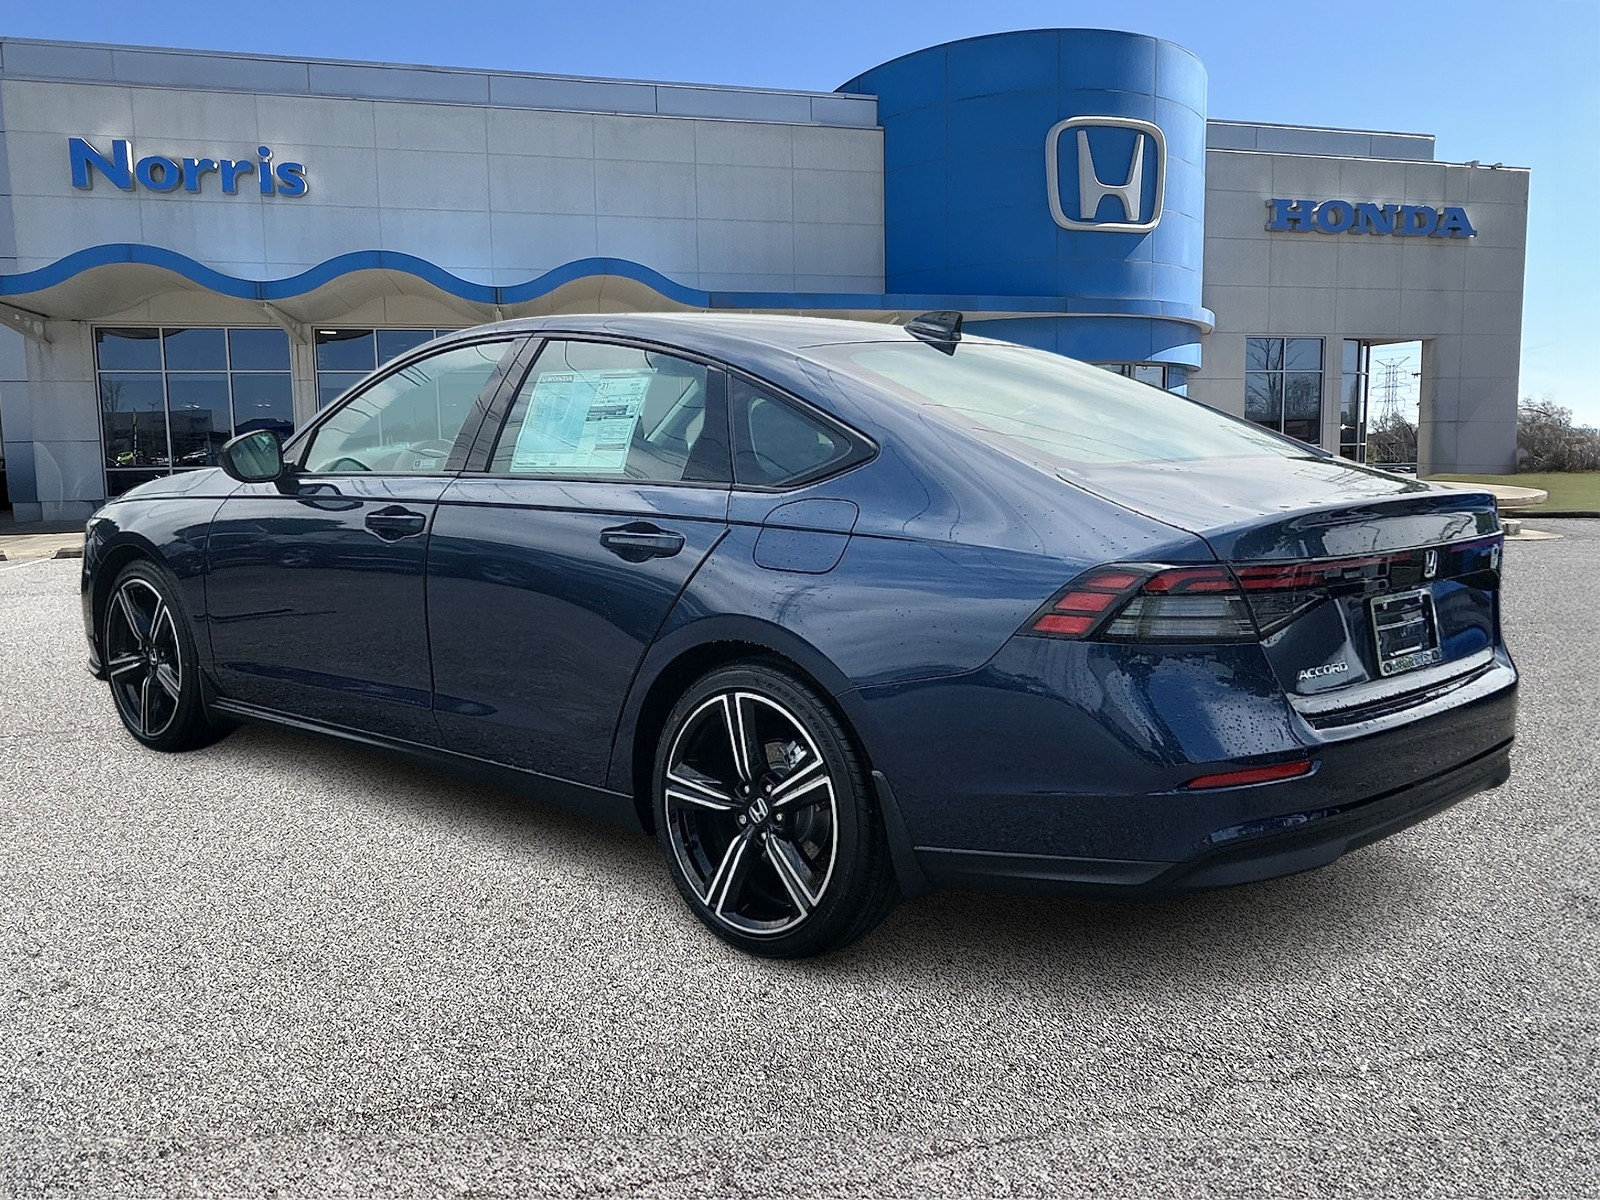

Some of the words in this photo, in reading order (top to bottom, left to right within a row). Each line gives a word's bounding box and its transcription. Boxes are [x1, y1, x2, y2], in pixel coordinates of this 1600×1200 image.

[68, 137, 308, 197] Norris
[1266, 198, 1477, 239] HONDA
[1299, 661, 1349, 681] ACCORD
